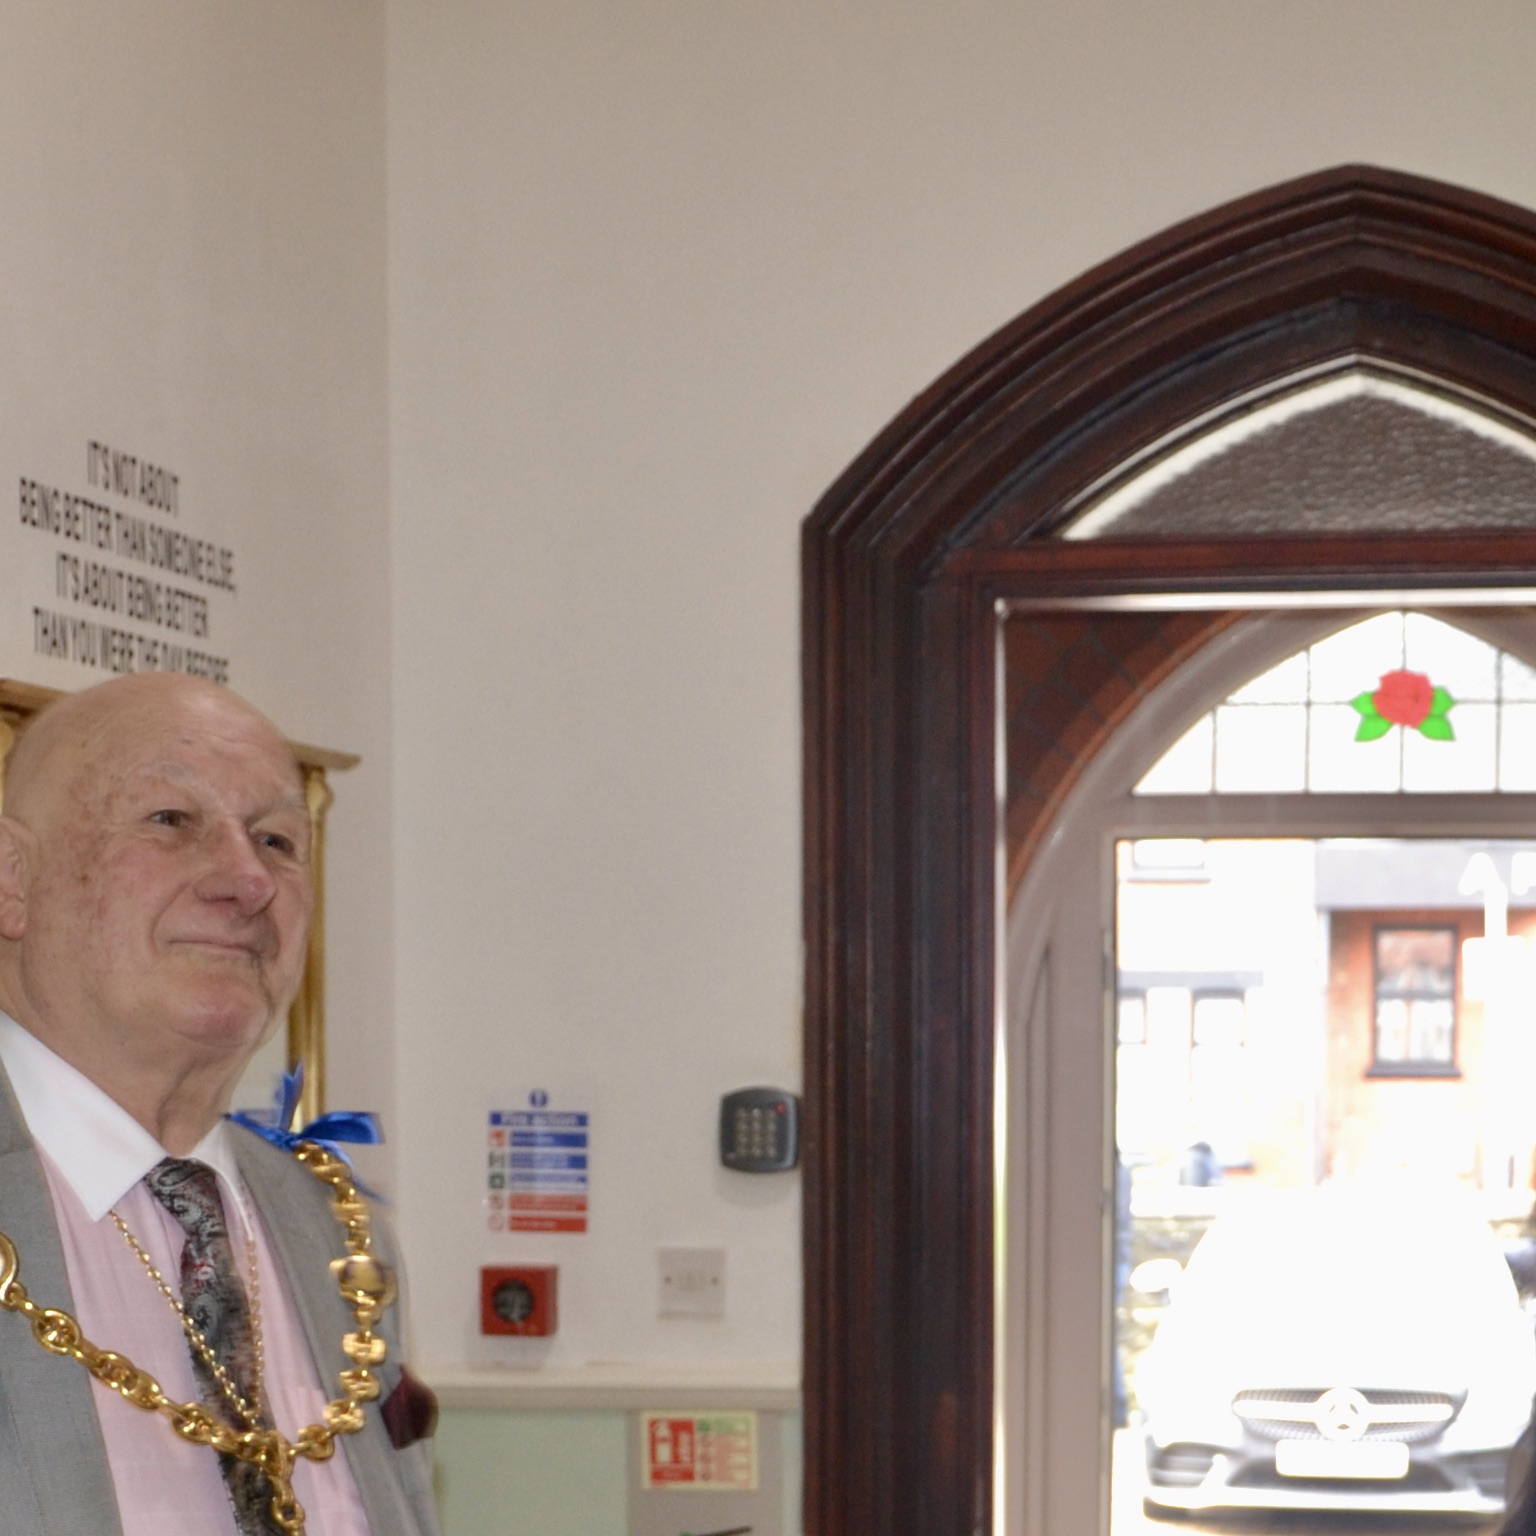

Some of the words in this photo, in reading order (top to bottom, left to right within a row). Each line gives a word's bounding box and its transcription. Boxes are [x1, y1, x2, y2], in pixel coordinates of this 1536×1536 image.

[87, 439, 110, 491] IT'S
[112, 450, 137, 499] NOT
[139, 460, 178, 518] ABOUT
[19, 476, 61, 535] BEING
[63, 492, 113, 550] BETTER
[115, 510, 146, 562] THAN
[149, 522, 203, 582] SOMEONE
[56, 552, 80, 602] IT'S
[82, 560, 124, 614] ABOUT
[126, 573, 162, 625] BEING
[164, 586, 207, 638] BETTER
[32, 605, 68, 660] THAN
[70, 617, 98, 666] YOU
[100, 626, 133, 673] WERE
